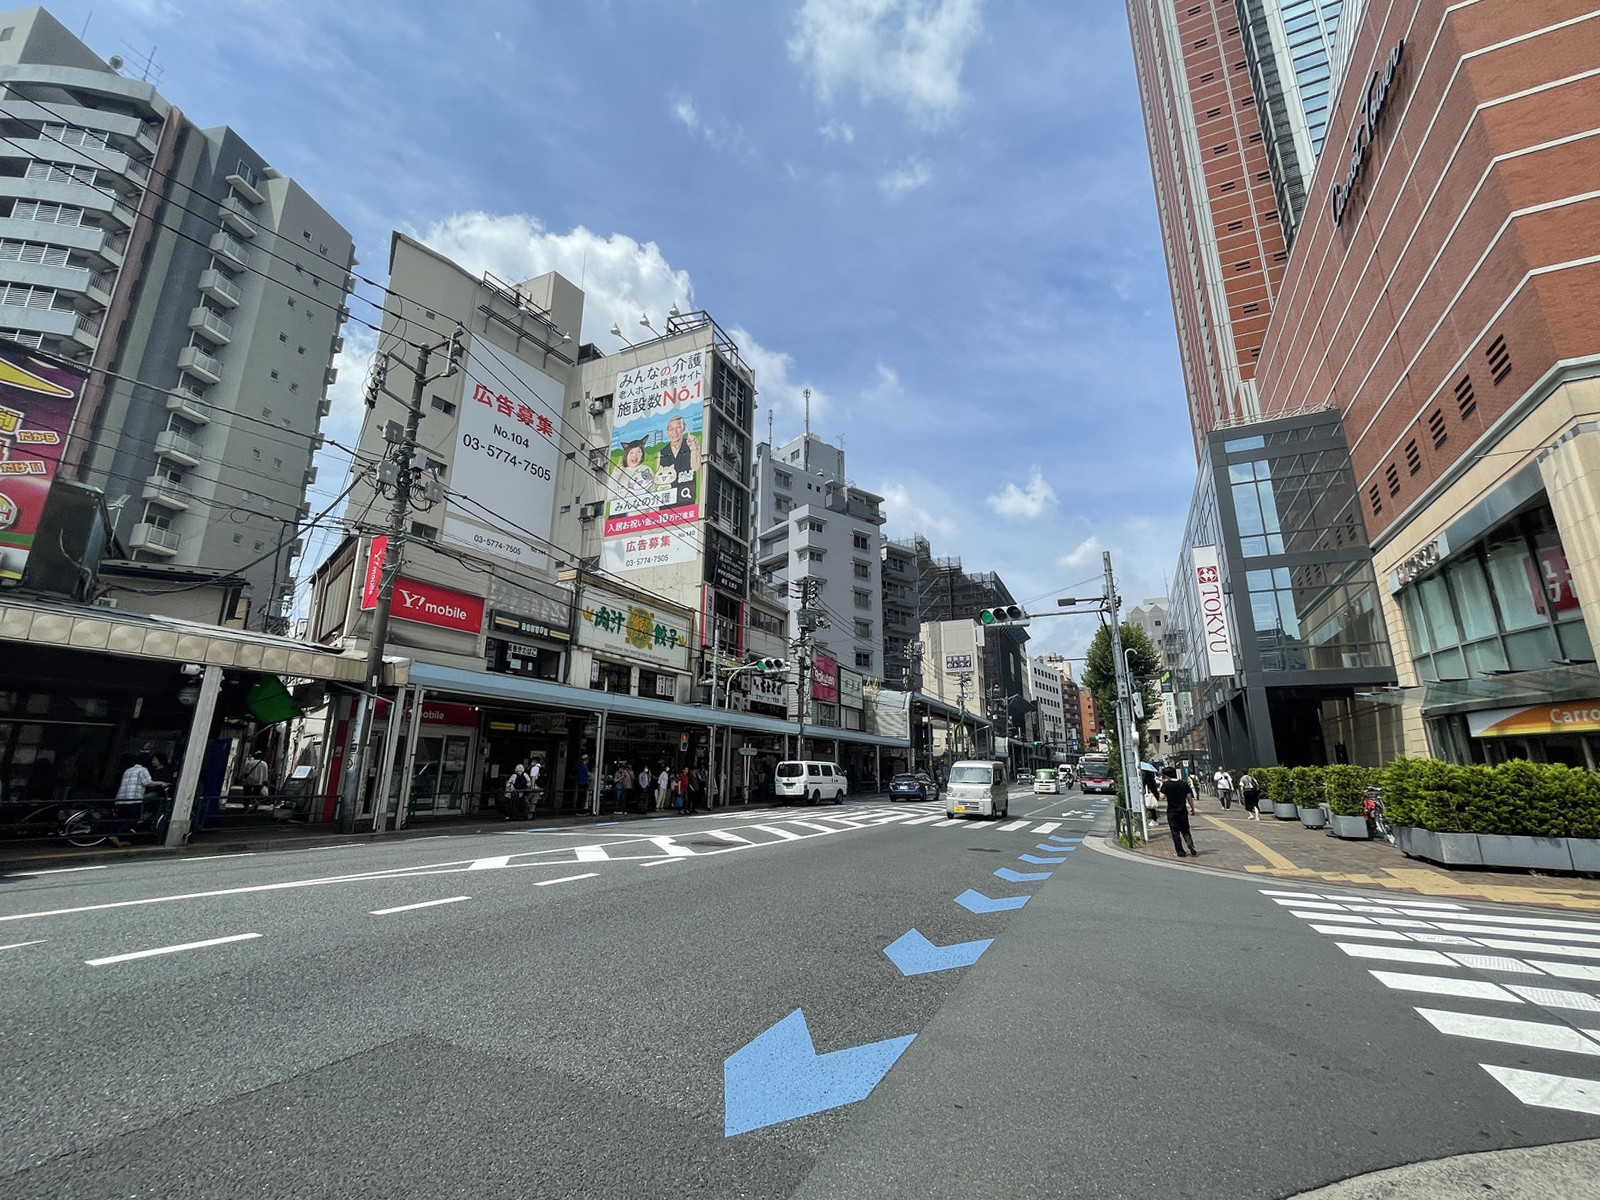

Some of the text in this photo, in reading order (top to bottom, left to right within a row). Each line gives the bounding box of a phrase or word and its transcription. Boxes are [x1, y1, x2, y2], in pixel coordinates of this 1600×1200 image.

[1361, 38, 1405, 143] Tower
[618, 370, 701, 400] 老人ホーム検索サイト
[619, 352, 702, 388] みんなの介護
[472, 383, 554, 438] 広告募集
[19, 431, 57, 443] だから
[493, 424, 530, 448] No.104
[463, 433, 552, 482] 03-5774-7505
[615, 492, 671, 511] みんなの介護
[473, 534, 522, 555] 03-5774-7505
[626, 535, 671, 553] 広告募集
[626, 554, 669, 567] 03-5774-7505
[594, 606, 626, 634] 肉汁
[654, 623, 678, 650] 餃子
[1202, 584, 1229, 654] TOKYU
